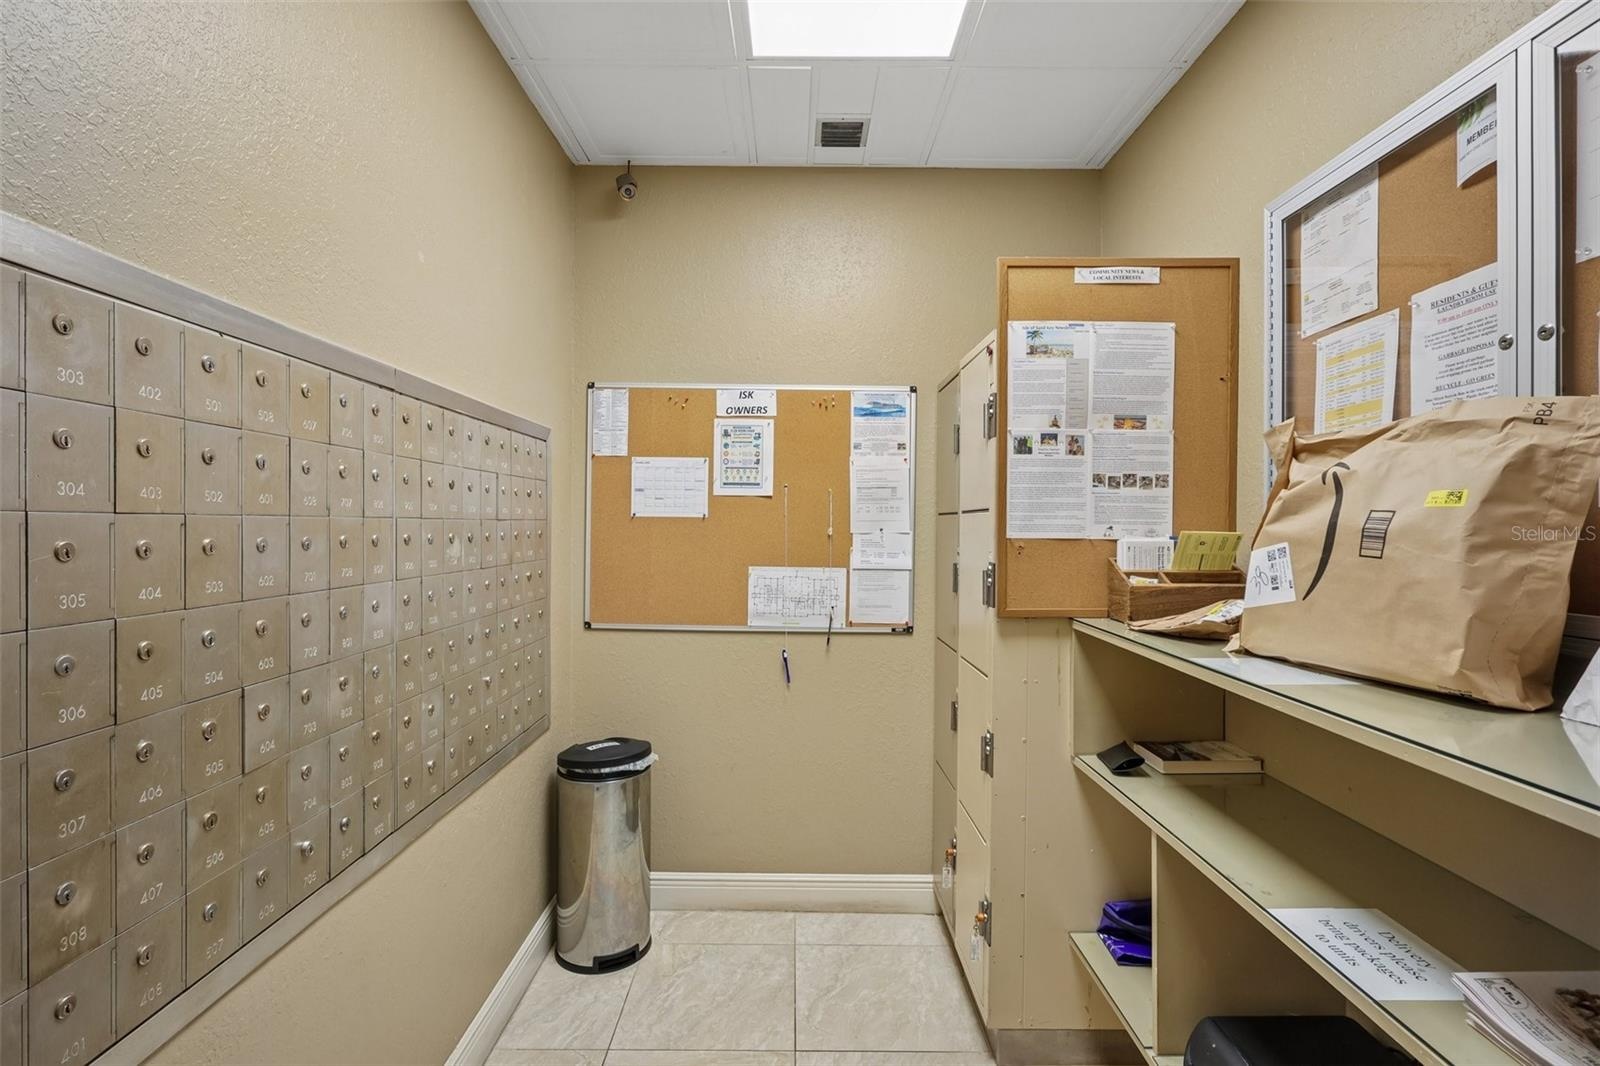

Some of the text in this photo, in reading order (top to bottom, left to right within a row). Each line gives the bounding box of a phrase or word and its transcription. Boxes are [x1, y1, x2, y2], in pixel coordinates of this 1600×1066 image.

[1430, 289, 1469, 309] RESIDENTS
[1438, 348, 1464, 361] GARBAGE
[56, 367, 84, 386] 303
[138, 386, 162, 400] 402
[1436, 381, 1462, 392] RECYCLE
[739, 391, 754, 399] ISK
[205, 398, 222, 412] 501
[726, 406, 768, 414] OWNERS
[1533, 402, 1557, 426] PB4
[56, 481, 86, 496] 304
[140, 487, 162, 499] 403
[204, 490, 222, 503] 502
[259, 493, 274, 504] 601
[205, 581, 224, 594] 503
[258, 575, 274, 587] 602
[59, 593, 86, 609] 305
[138, 587, 162, 600] 404
[304, 646, 318, 658] 702
[258, 657, 274, 670] 603
[205, 670, 224, 685] 504
[140, 685, 164, 701] 405
[58, 705, 86, 724] 306
[304, 721, 317, 735] 703
[260, 739, 276, 754] 604
[205, 759, 224, 776] 505
[138, 784, 164, 804] 406
[58, 815, 86, 838] 307
[258, 820, 276, 837] 605
[206, 852, 225, 868] 506
[140, 882, 164, 904] 407
[59, 926, 88, 952] 308
[1314, 934, 1360, 967] to units
[1318, 919, 1408, 985] bring packages
[1343, 920, 1428, 982] drivers please
[1378, 930, 1436, 969] Delivery
[140, 983, 163, 1007] 408
[60, 1037, 87, 1064] 401
